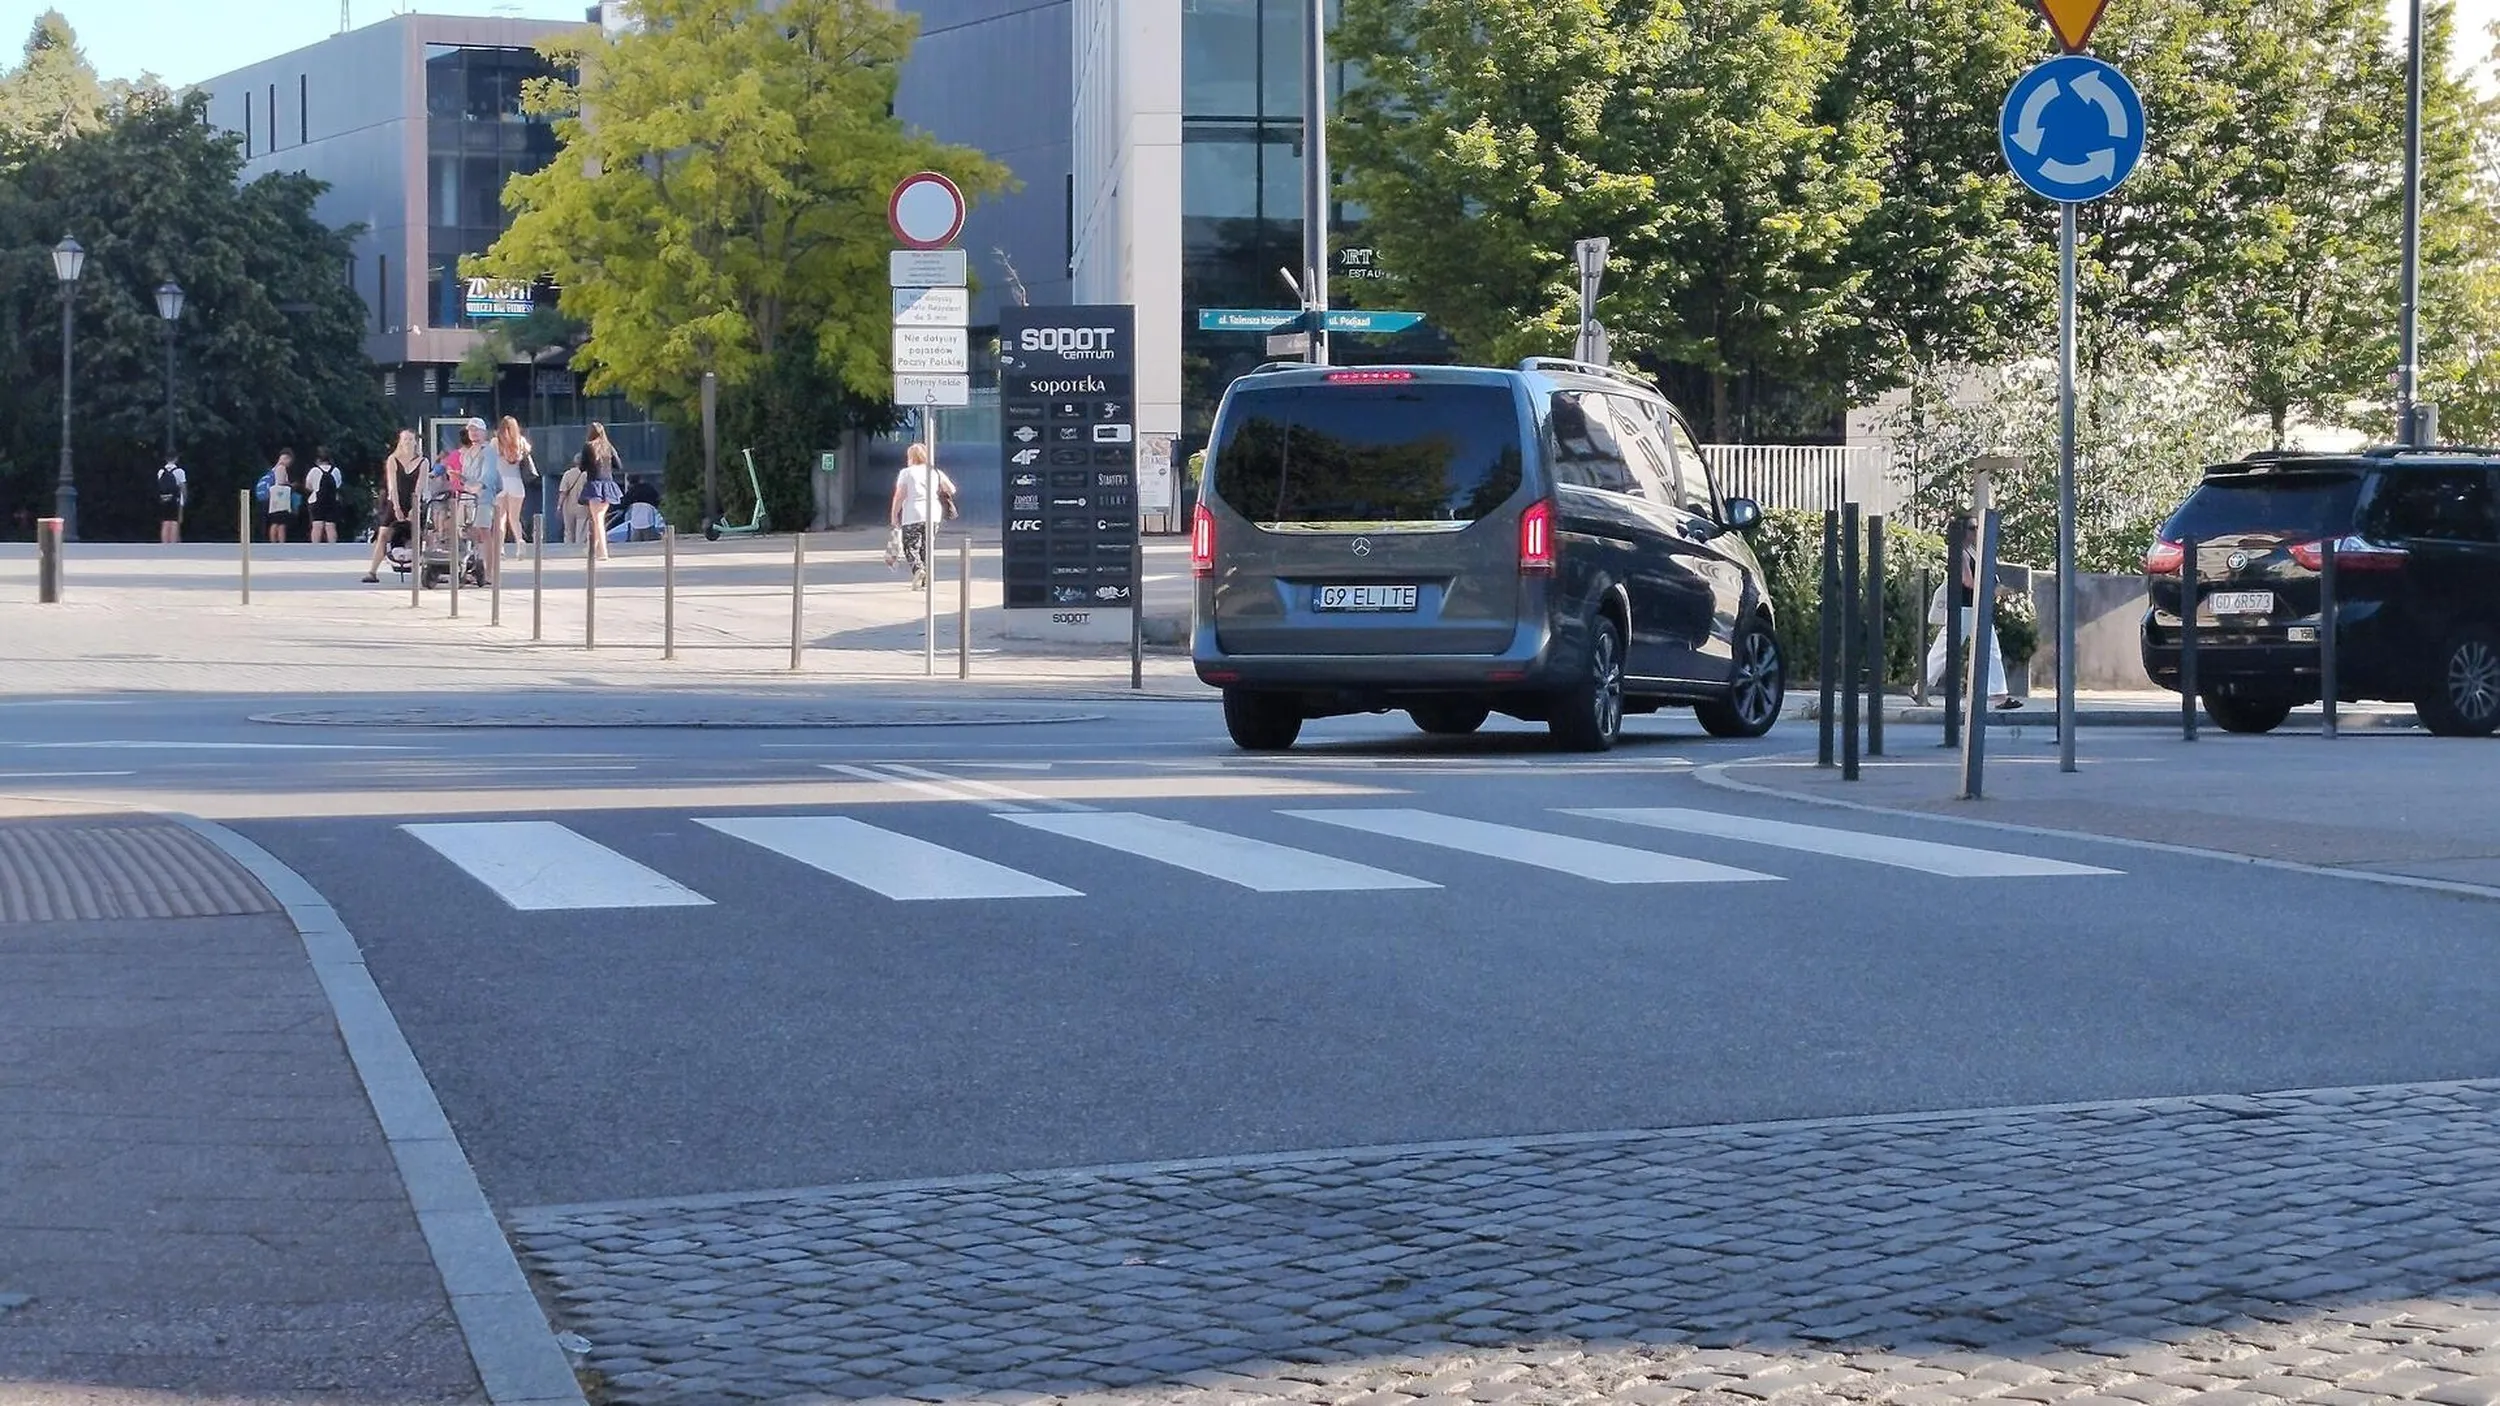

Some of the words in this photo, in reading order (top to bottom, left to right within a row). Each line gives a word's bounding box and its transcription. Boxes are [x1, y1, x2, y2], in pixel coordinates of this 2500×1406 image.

[904, 333, 920, 342] Nie
[1011, 448, 1041, 465] 4F
[1010, 520, 1043, 532] KFC
[1324, 587, 1347, 605] G9
[1353, 587, 1415, 605] ELITE
[2215, 594, 2231, 609] GD
[2234, 594, 2271, 610] 6R573
